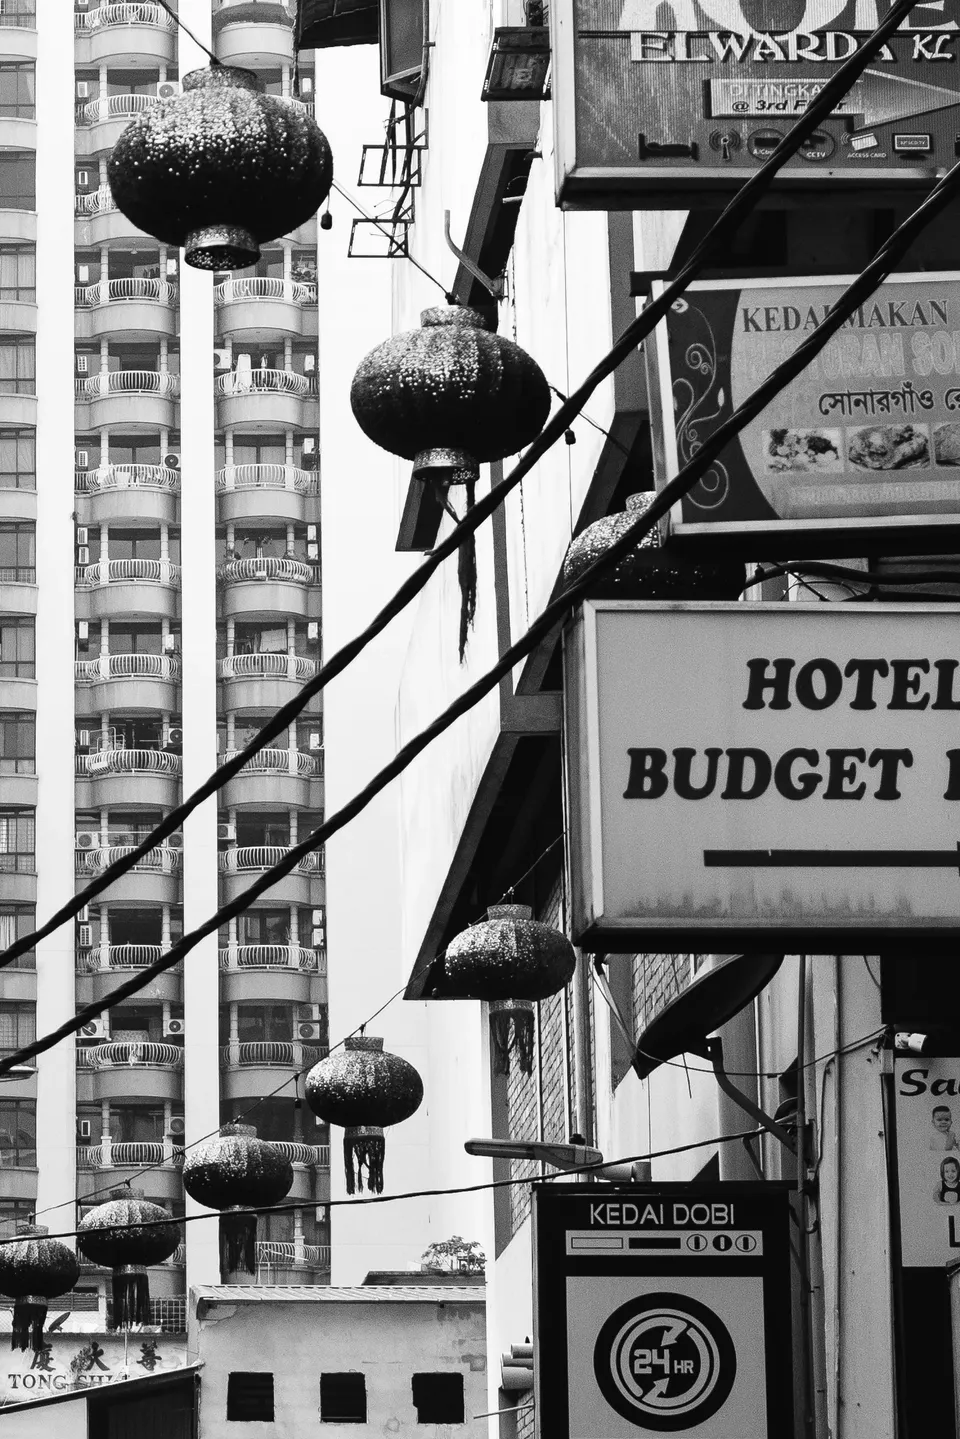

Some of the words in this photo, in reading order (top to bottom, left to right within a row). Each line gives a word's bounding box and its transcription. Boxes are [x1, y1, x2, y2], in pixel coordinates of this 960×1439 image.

[911, 33, 954, 61] KL
[752, 84, 828, 96] TINGKA
[756, 100, 788, 110] 3rd
[842, 300, 948, 329] MAKAN
[742, 657, 960, 711] HOTEL
[622, 747, 913, 801] BUDGET
[900, 1069, 960, 1097] Sa
[590, 1203, 664, 1225] KEDAI
[673, 1203, 735, 1225] DOBI
[633, 1348, 670, 1375] 24
[674, 1359, 694, 1375] HR
[8, 1374, 67, 1390] TONG
